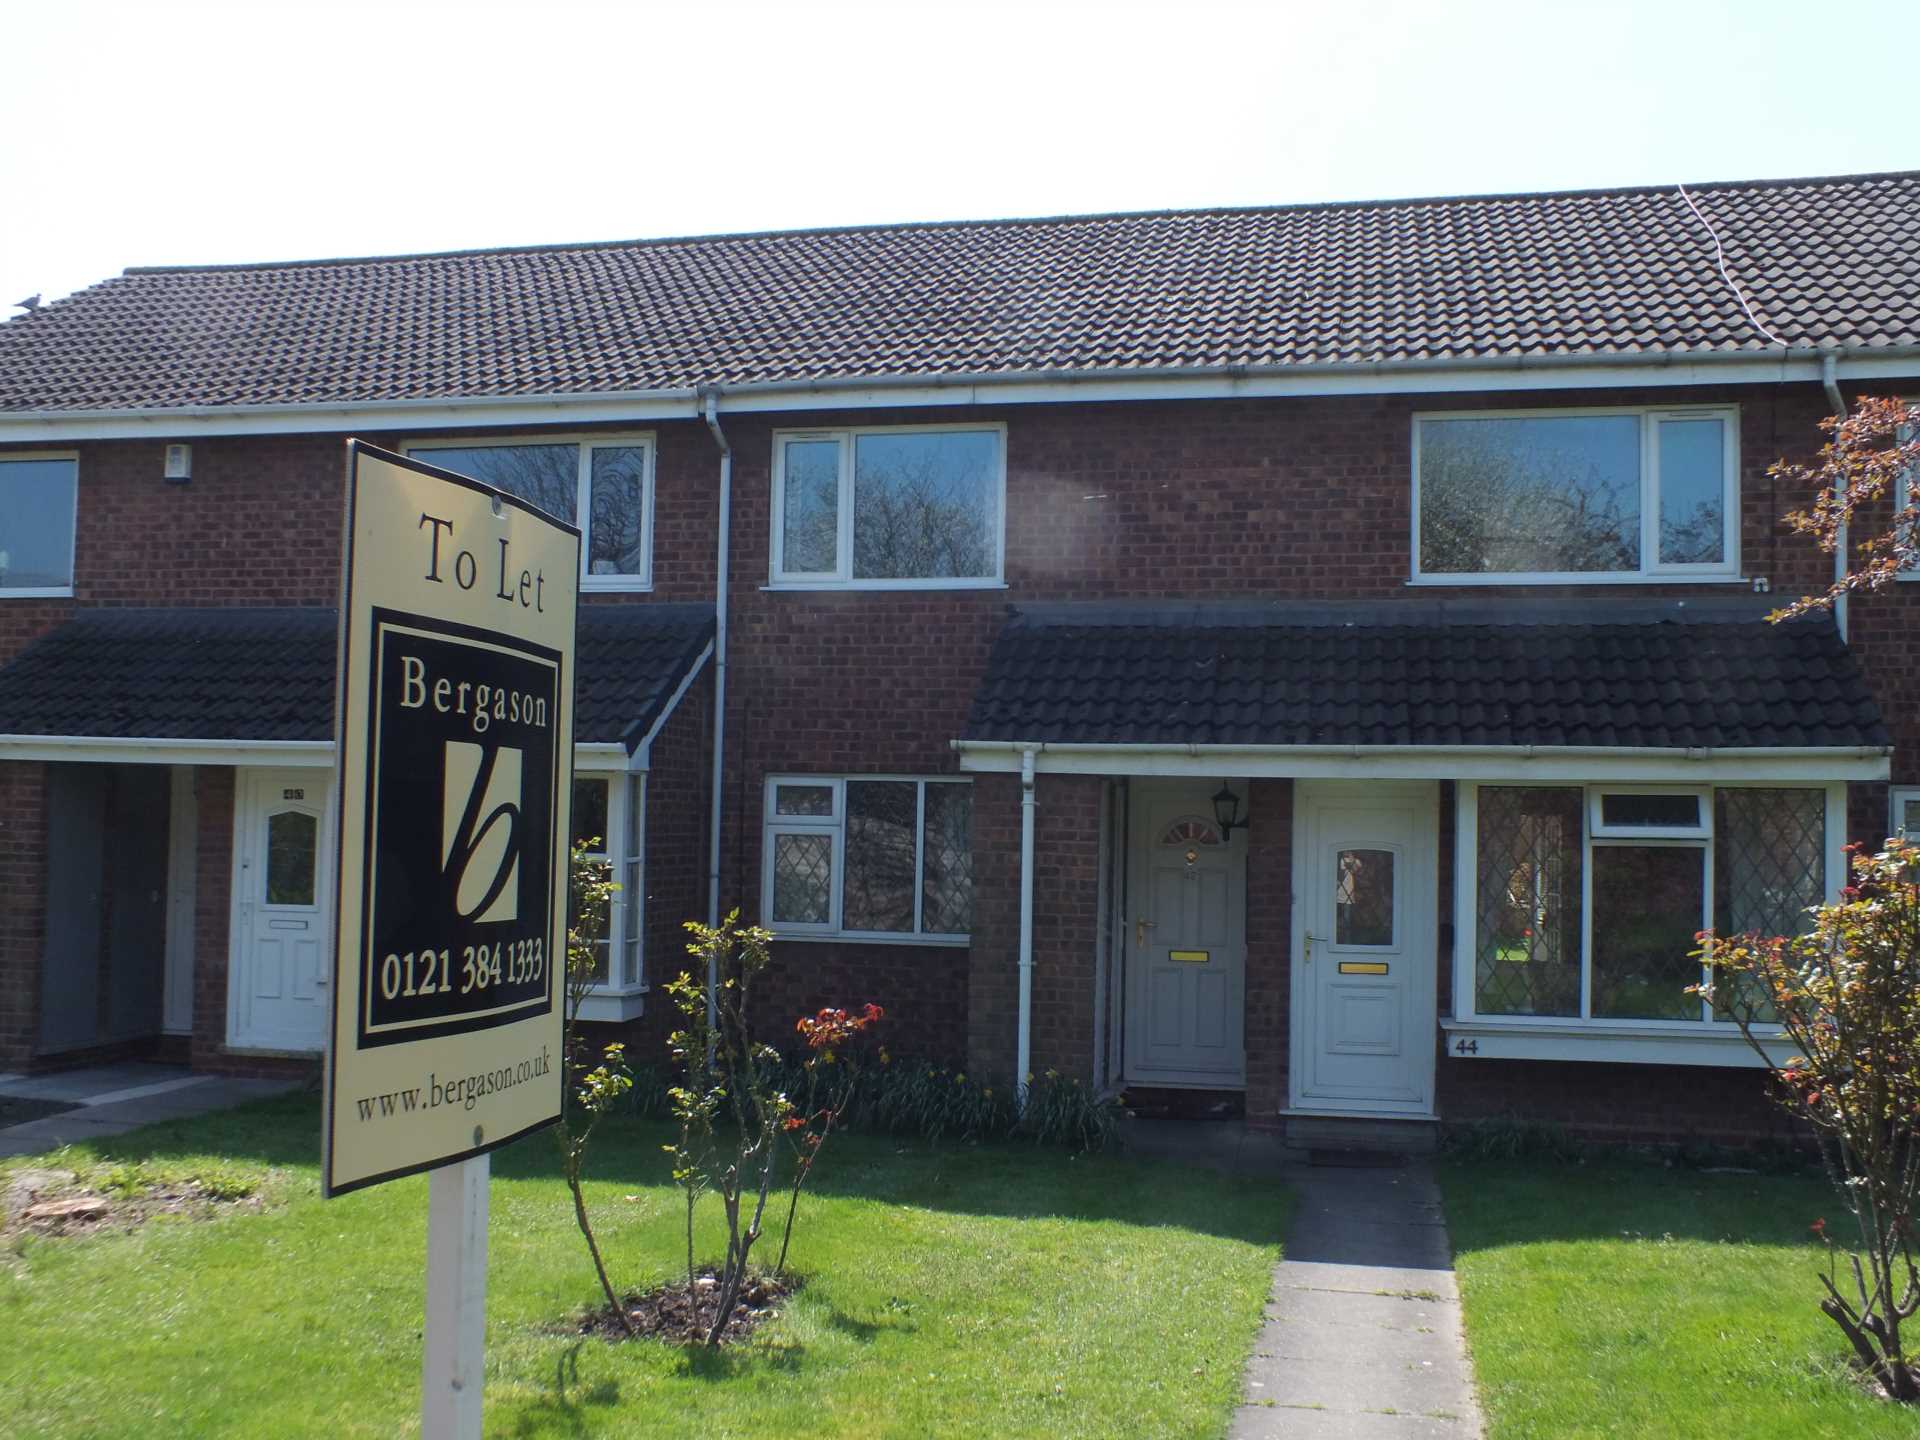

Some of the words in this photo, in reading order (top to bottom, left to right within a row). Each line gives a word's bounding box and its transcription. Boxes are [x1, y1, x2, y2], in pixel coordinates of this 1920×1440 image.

[418, 512, 477, 590] To
[497, 538, 545, 613] Let
[400, 656, 547, 733] Bergason
[381, 948, 452, 1000] 0121
[461, 942, 503, 994] 384
[507, 937, 545, 985] 1333
[357, 1045, 551, 1122] www.bergason.co.uk
[1456, 1038, 1478, 1054] 44
